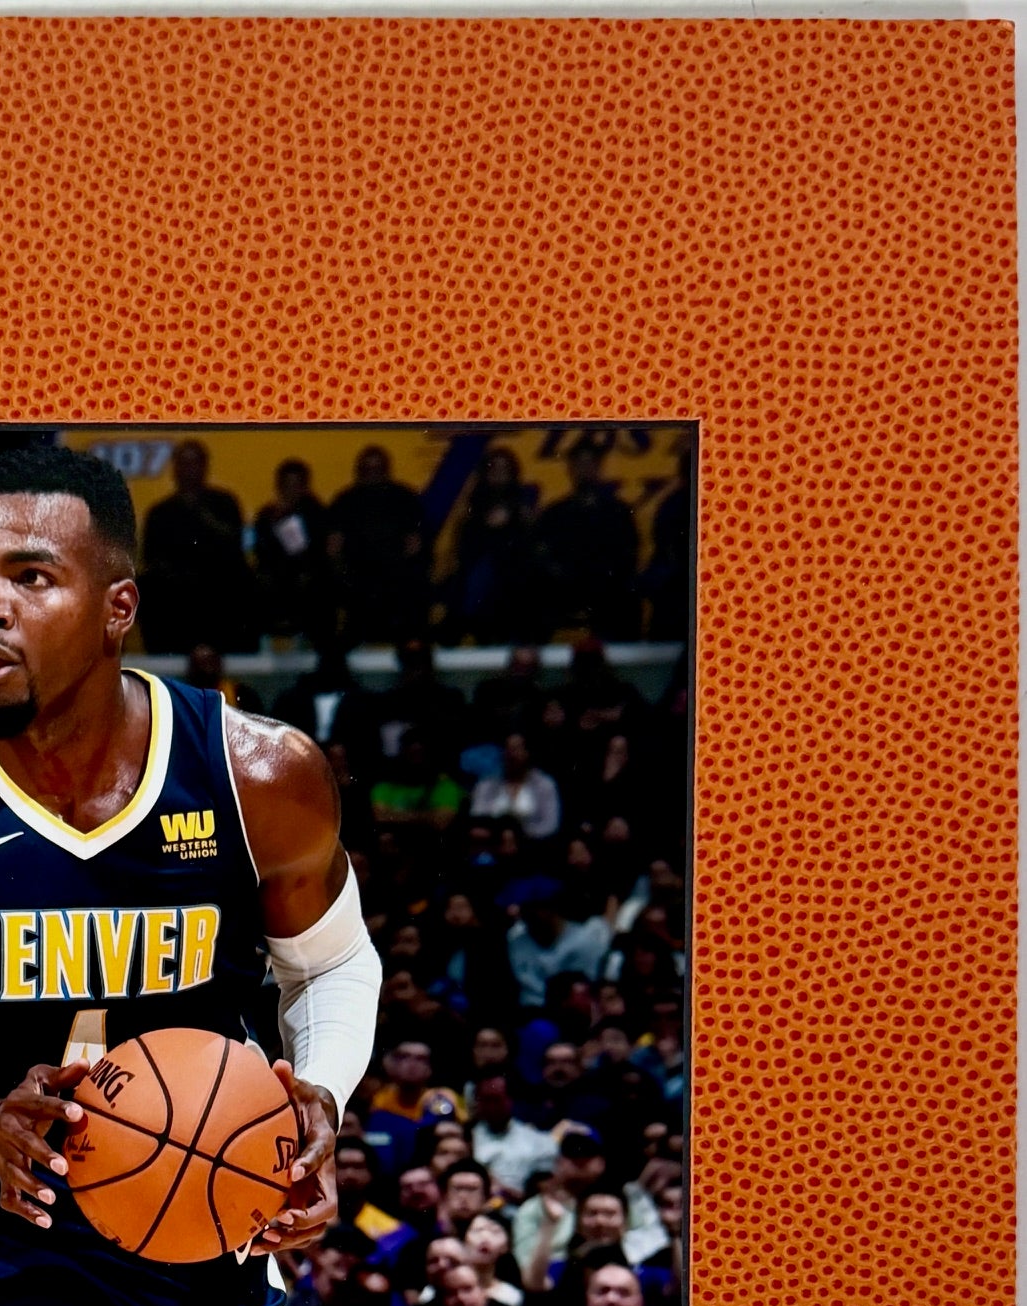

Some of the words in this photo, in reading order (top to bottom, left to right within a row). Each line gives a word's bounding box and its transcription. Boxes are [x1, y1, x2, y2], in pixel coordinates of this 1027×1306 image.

[160, 810, 215, 842] WU
[162, 840, 217, 853] WESTERN
[180, 849, 217, 860] UNION
